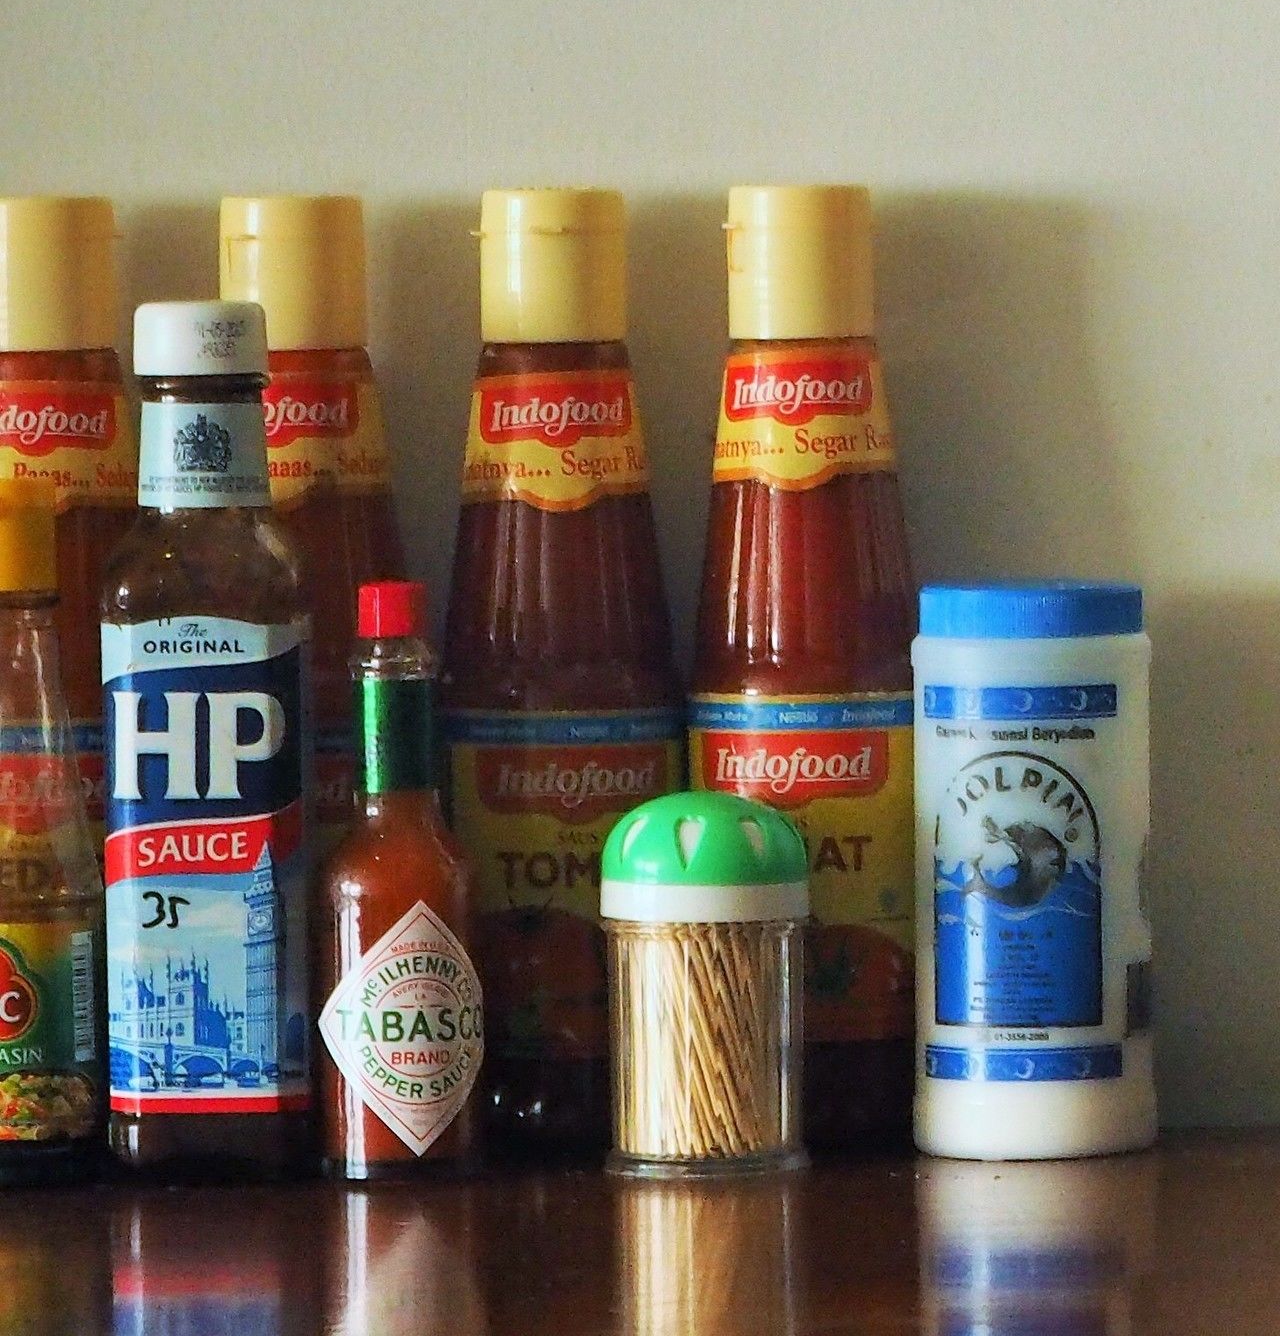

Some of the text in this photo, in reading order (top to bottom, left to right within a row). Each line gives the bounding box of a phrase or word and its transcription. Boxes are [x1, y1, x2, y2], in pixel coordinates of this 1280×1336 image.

[733, 373, 863, 415] Indofood
[0, 403, 107, 446] dofood
[262, 396, 348, 436] ofood
[490, 396, 624, 437] Indofood
[794, 428, 858, 460] Segar
[560, 449, 619, 481] Segar
[143, 639, 245, 654] ORIGINAL
[178, 623, 208, 639] The
[112, 690, 286, 800] HP
[496, 760, 656, 809] Indofood
[716, 746, 872, 794] Indofood
[138, 831, 249, 868] SAUCE
[498, 851, 601, 889] TOM
[142, 890, 191, 929] 35
[361, 1045, 424, 1099] PEPPER
[391, 1049, 451, 1065] BRAND
